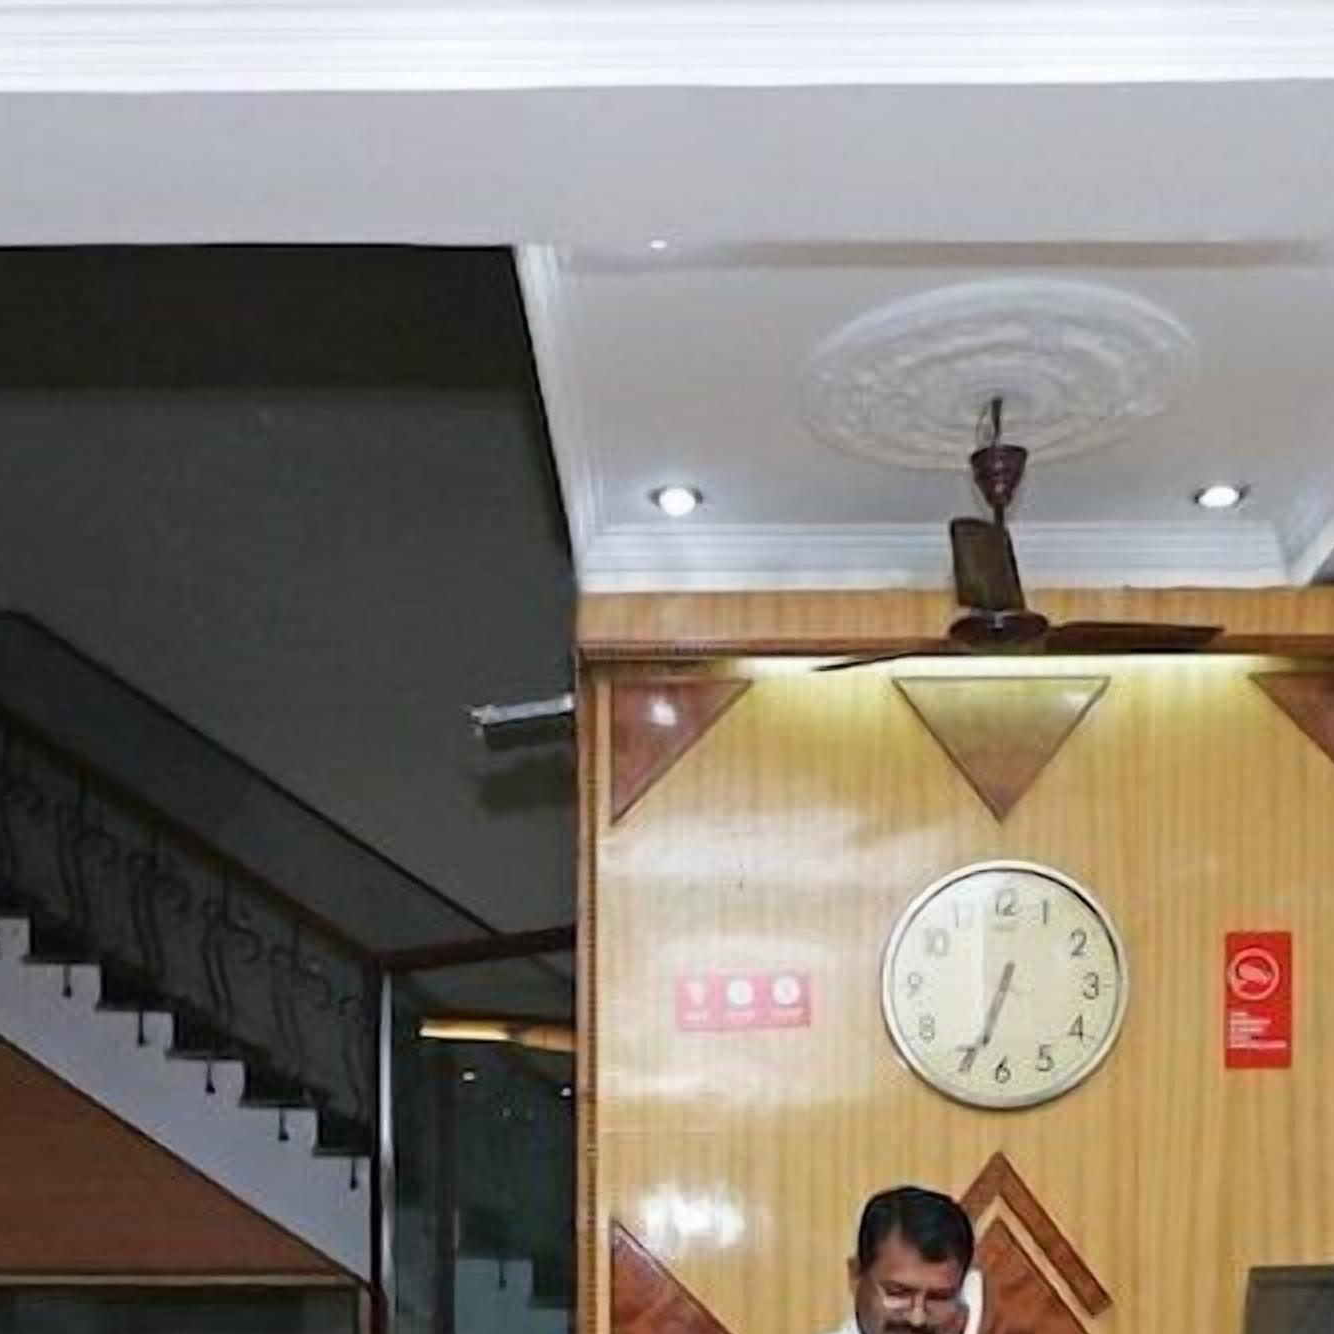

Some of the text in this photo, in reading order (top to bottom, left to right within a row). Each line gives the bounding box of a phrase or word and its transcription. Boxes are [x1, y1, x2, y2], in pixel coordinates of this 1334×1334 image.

[994, 889, 1017, 916] 12
[1071, 930, 1087, 956] 2
[908, 973, 922, 998] 9
[1082, 973, 1099, 999] 3
[919, 1016, 934, 1041] 8
[1068, 1015, 1083, 1040] 4
[995, 1057, 1011, 1083] 6
[1036, 1045, 1054, 1071] 5
